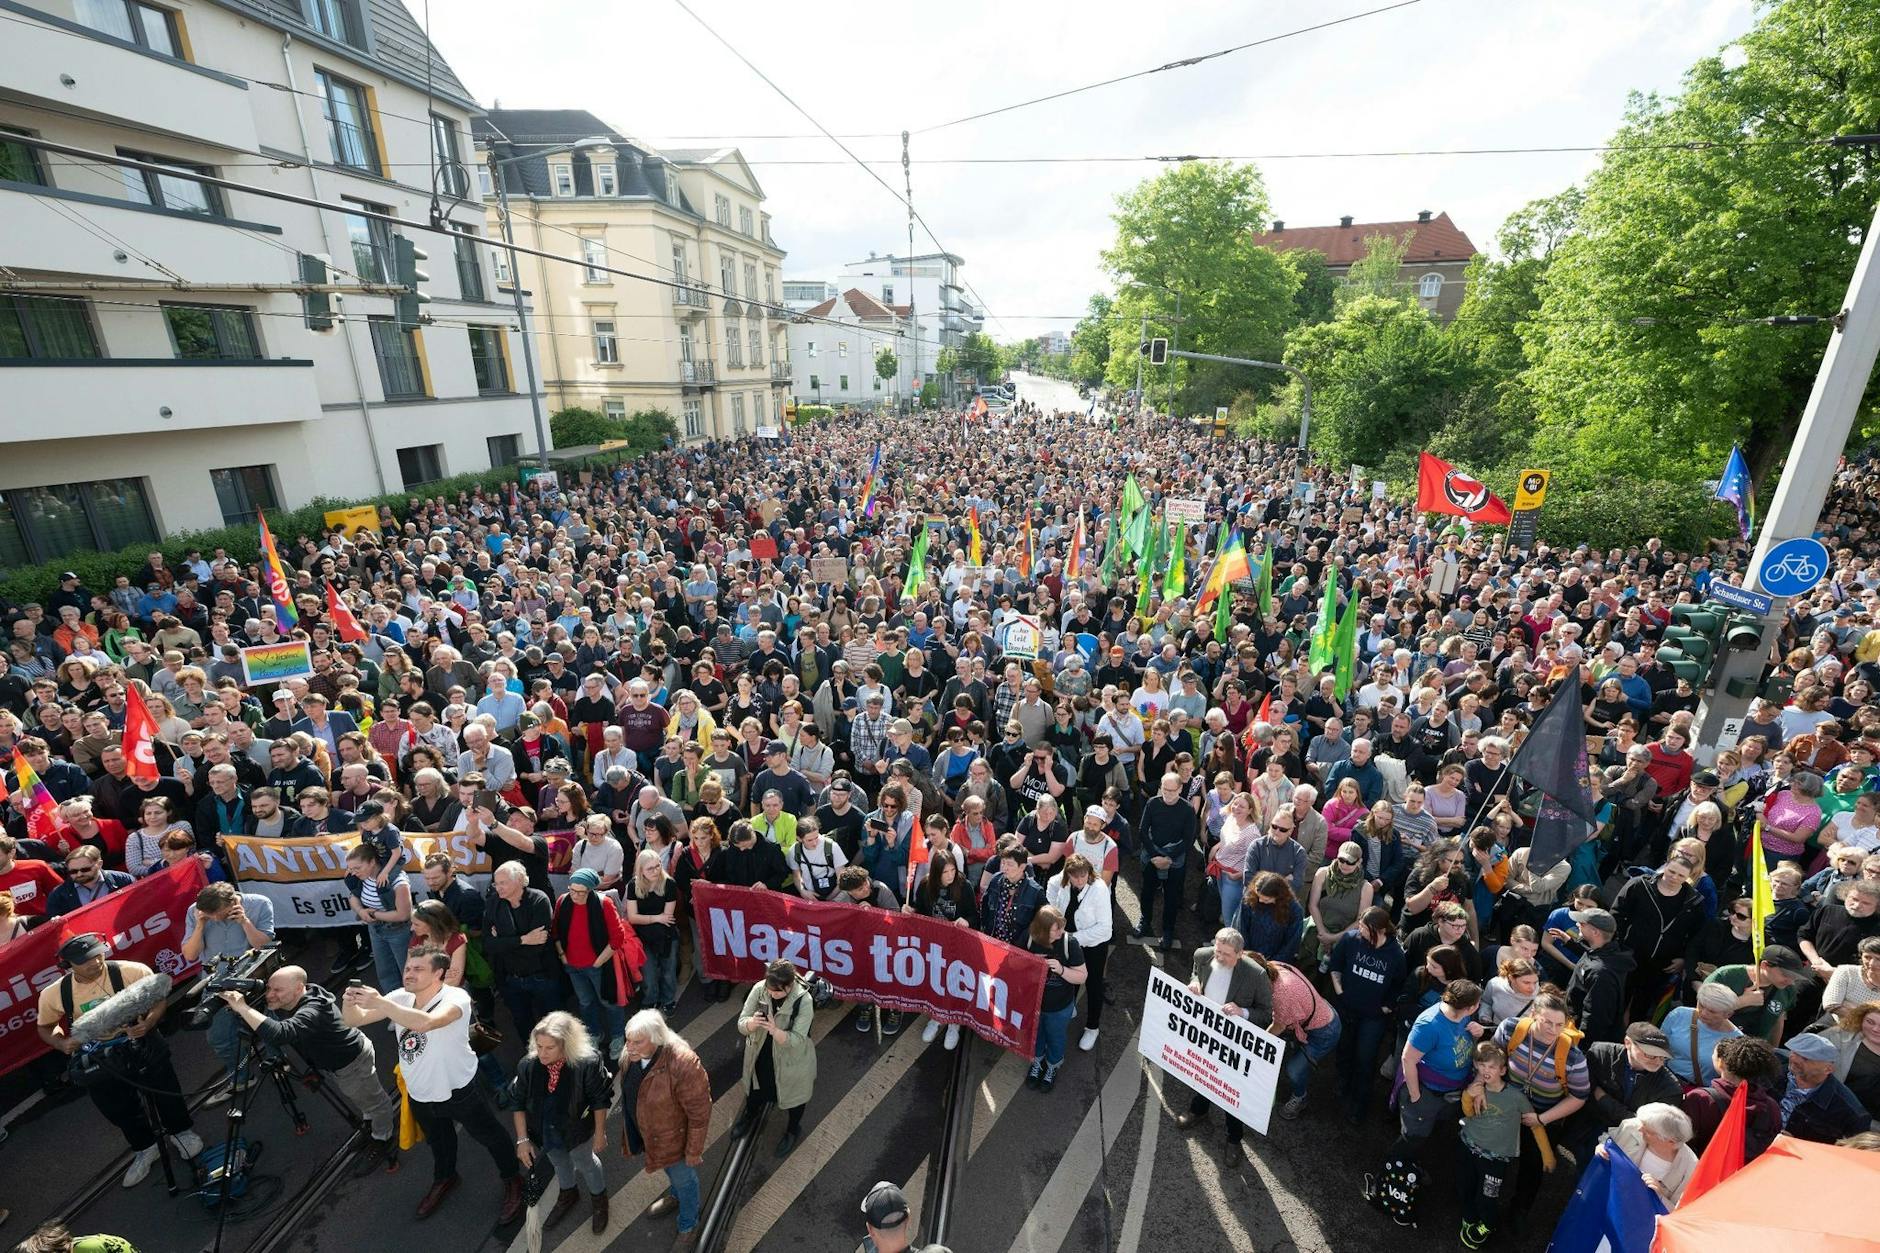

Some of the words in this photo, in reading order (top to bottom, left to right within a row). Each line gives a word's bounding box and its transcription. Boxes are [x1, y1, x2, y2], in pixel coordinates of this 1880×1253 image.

[1714, 586, 1751, 605] Schandauer
[1753, 598, 1766, 610] Str.
[1022, 785, 1041, 801] LIEB
[16, 892, 34, 901] SPD
[291, 897, 316, 914] Es
[709, 907, 854, 976] Nazis
[869, 935, 1023, 1030] töten.
[1356, 952, 1387, 971] MOIN
[1352, 964, 1385, 984] LIEBE
[1152, 977, 1277, 1065] HASSPREDIGER
[1168, 1012, 1242, 1070] STOPPEN
[1187, 1048, 1202, 1062] Kein
[1202, 1055, 1219, 1073] Platz
[1168, 1059, 1194, 1078] unserer
[1194, 1072, 1236, 1106] Gesellschaft
[1174, 1048, 1209, 1078] Rassismus
[1209, 1070, 1223, 1086] und
[1223, 1080, 1240, 1098] Hass
[1389, 1184, 1408, 1203] Volt
